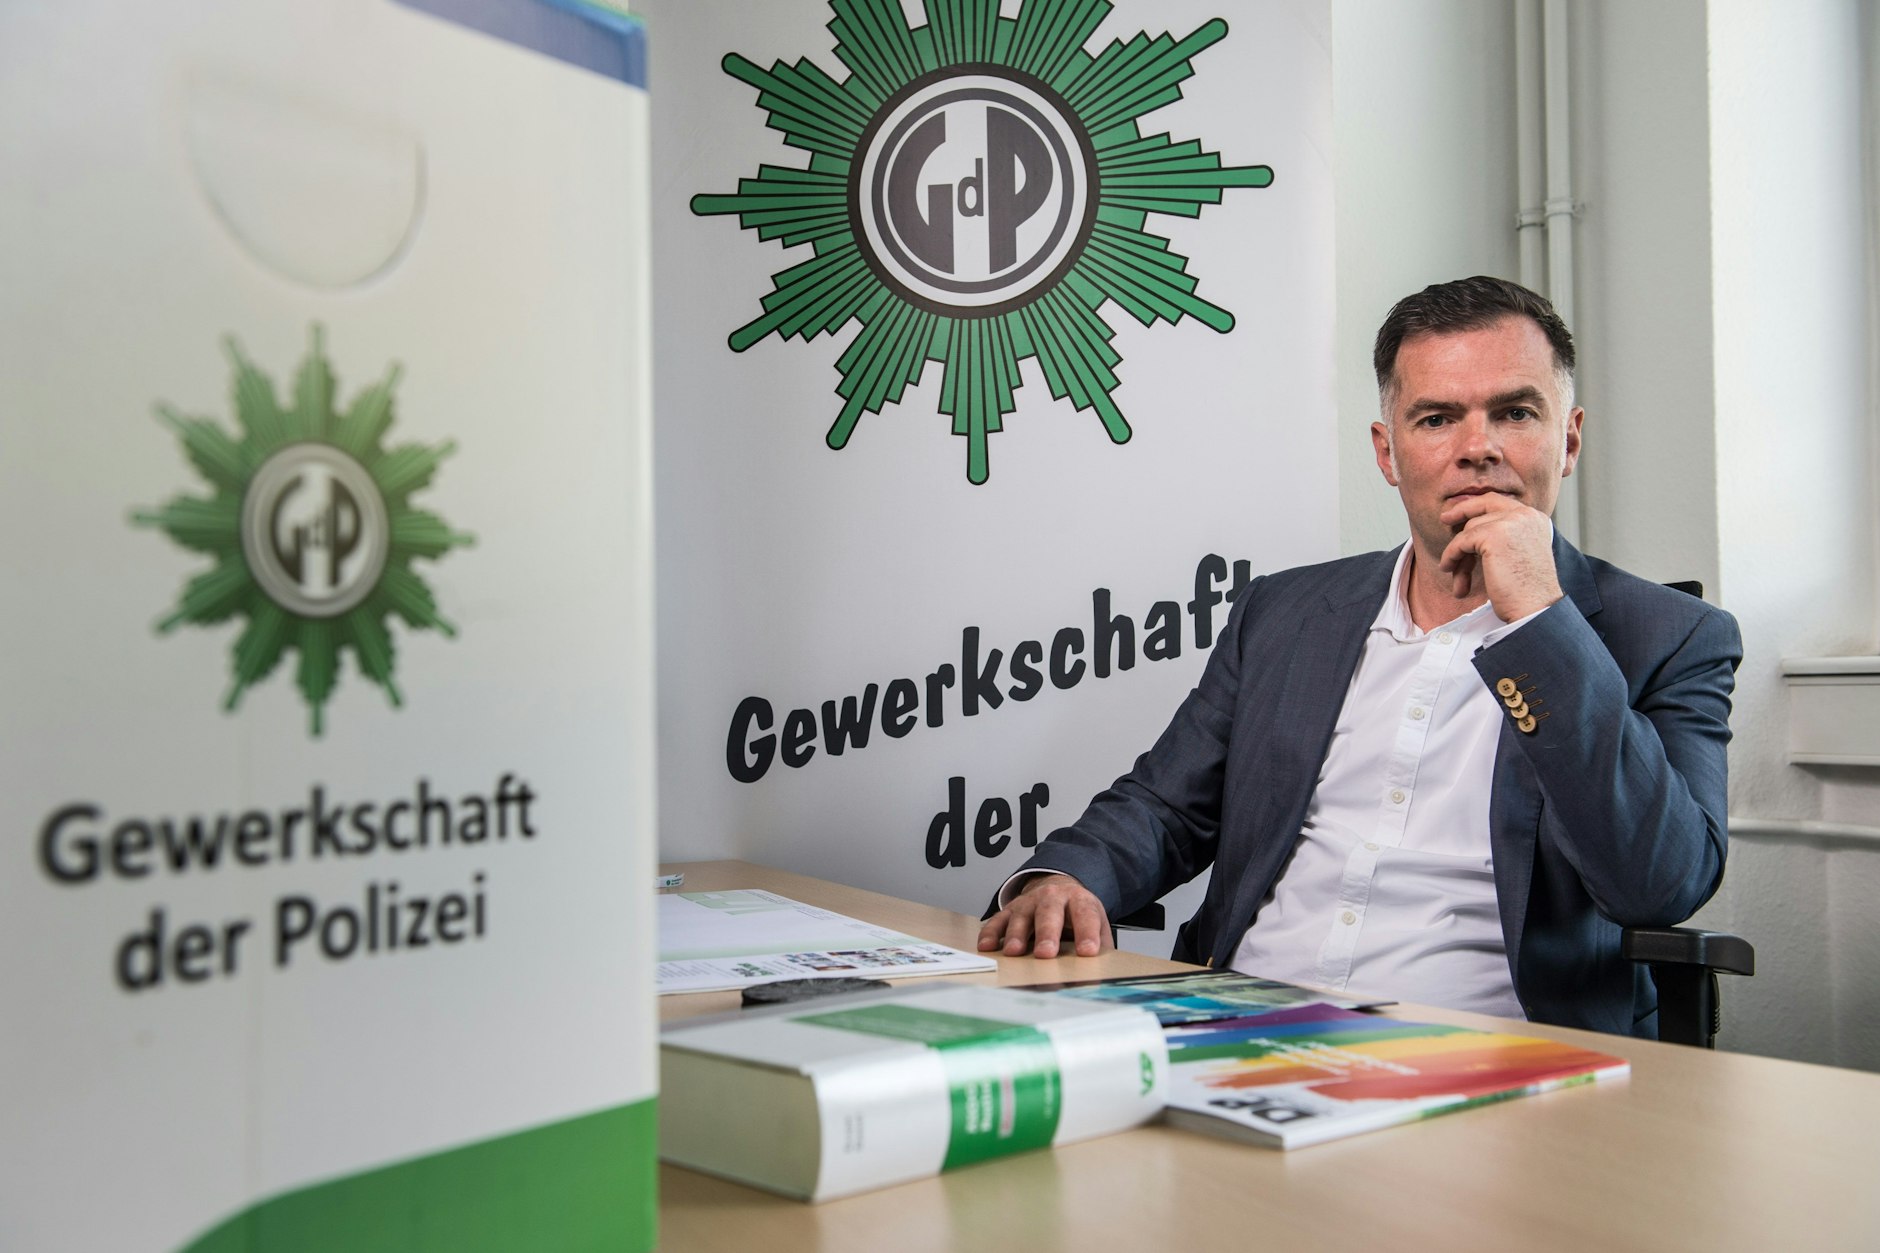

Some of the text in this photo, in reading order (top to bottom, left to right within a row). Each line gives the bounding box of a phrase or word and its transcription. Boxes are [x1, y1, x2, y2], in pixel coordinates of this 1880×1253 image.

[887, 106, 1054, 275] GdP
[270, 474, 363, 587] GdP
[38, 774, 537, 885] Gewerkschaft
[925, 776, 1049, 869] der
[115, 873, 487, 992] der Polizei
